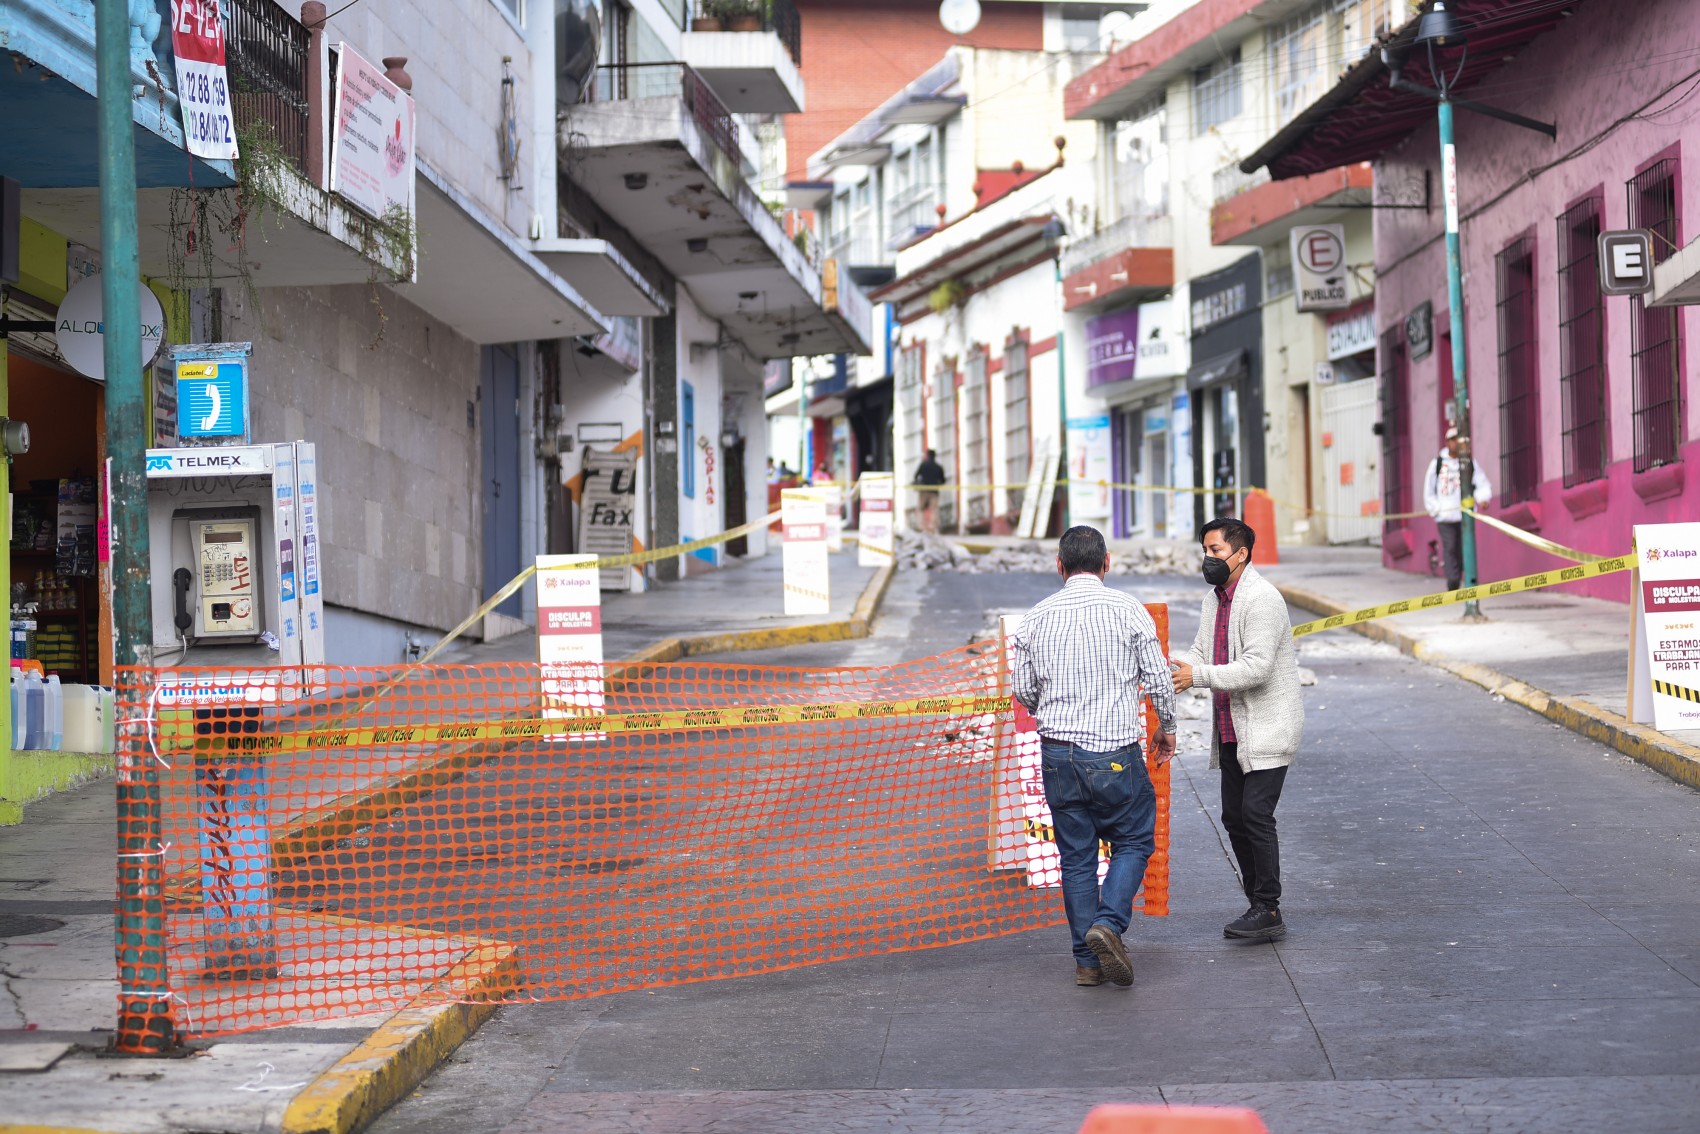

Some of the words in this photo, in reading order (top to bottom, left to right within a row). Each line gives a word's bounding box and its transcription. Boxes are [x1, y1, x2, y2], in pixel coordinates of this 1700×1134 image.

[1309, 236, 1334, 267] E
[1613, 243, 1643, 278] E
[176, 455, 241, 468] TELMEX
[589, 503, 632, 526] Fax
[1663, 549, 1697, 559] Xalapa
[1598, 558, 1625, 573] PRECAUCION
[560, 578, 591, 587] Xalapa
[1653, 585, 1700, 597] DISCULPA
[1668, 595, 1700, 604] MOLESTIA
[548, 612, 592, 622] DISCULPA
[1660, 639, 1700, 650] ESTAMO
[1654, 651, 1700, 660] TRABAJAN
[1666, 661, 1690, 671] PARA
